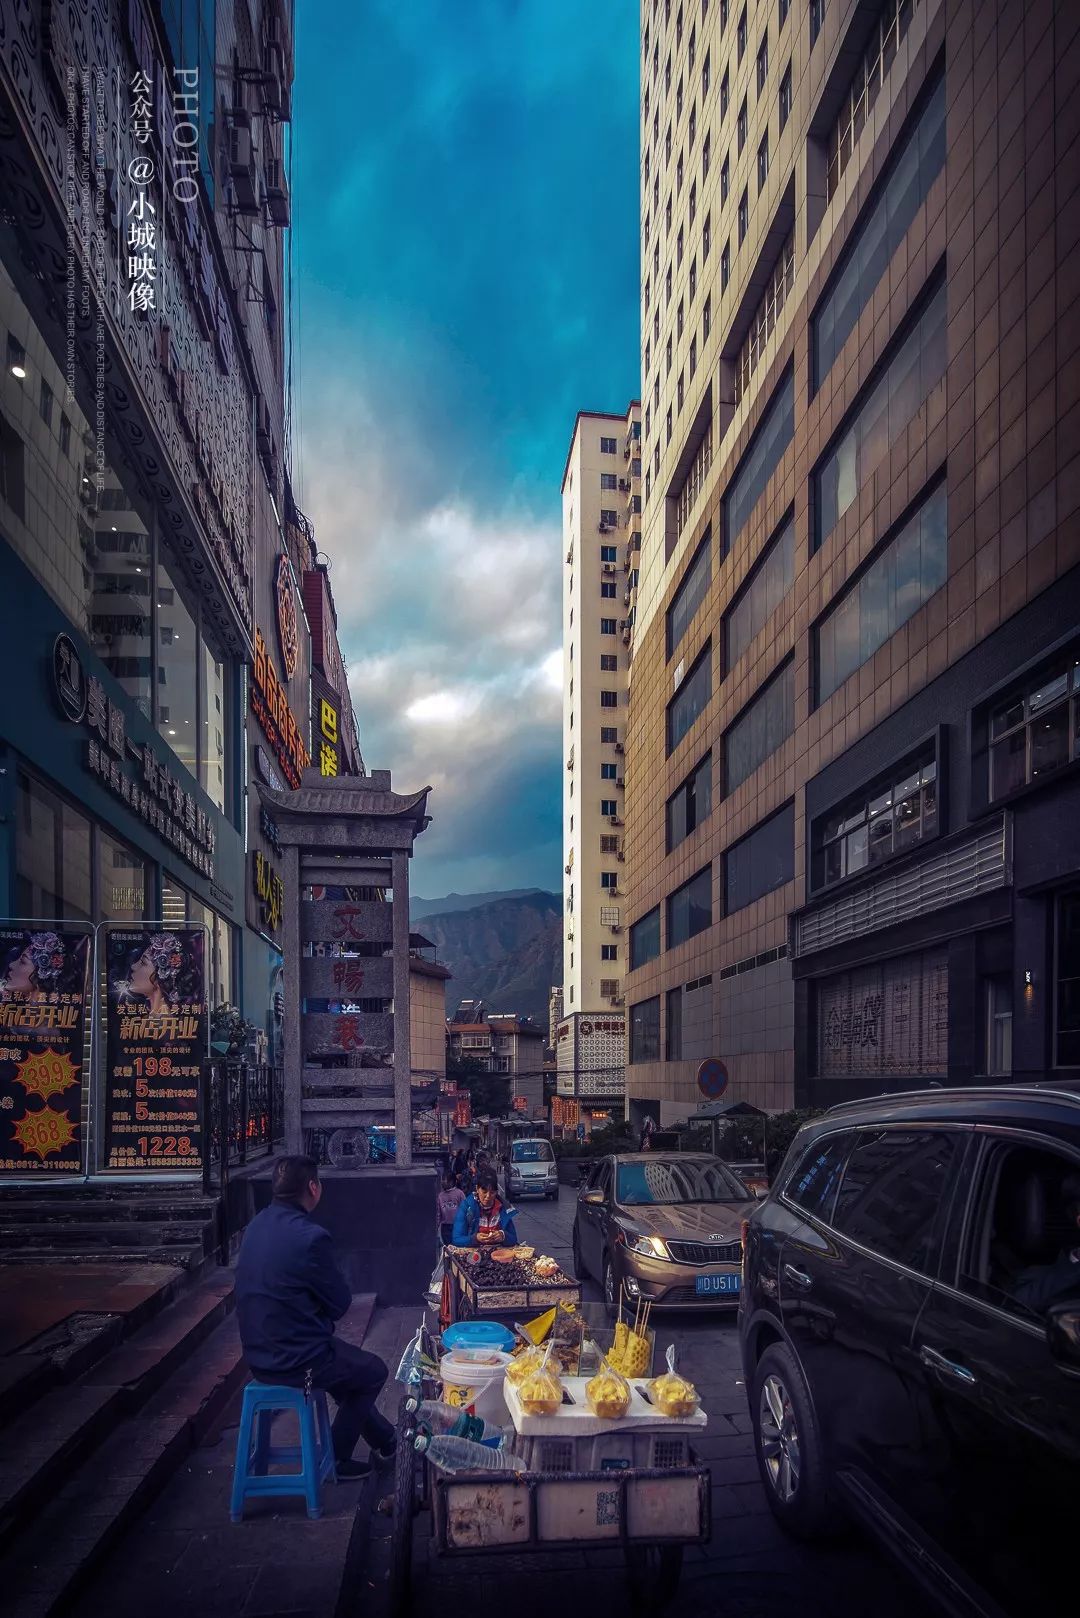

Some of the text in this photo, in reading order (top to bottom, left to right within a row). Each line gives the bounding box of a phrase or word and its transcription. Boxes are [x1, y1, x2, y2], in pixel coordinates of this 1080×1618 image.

[116, 1003, 202, 1015] 发型私人量身定制
[119, 1016, 199, 1041] 新店开业
[25, 1119, 60, 1147] 368
